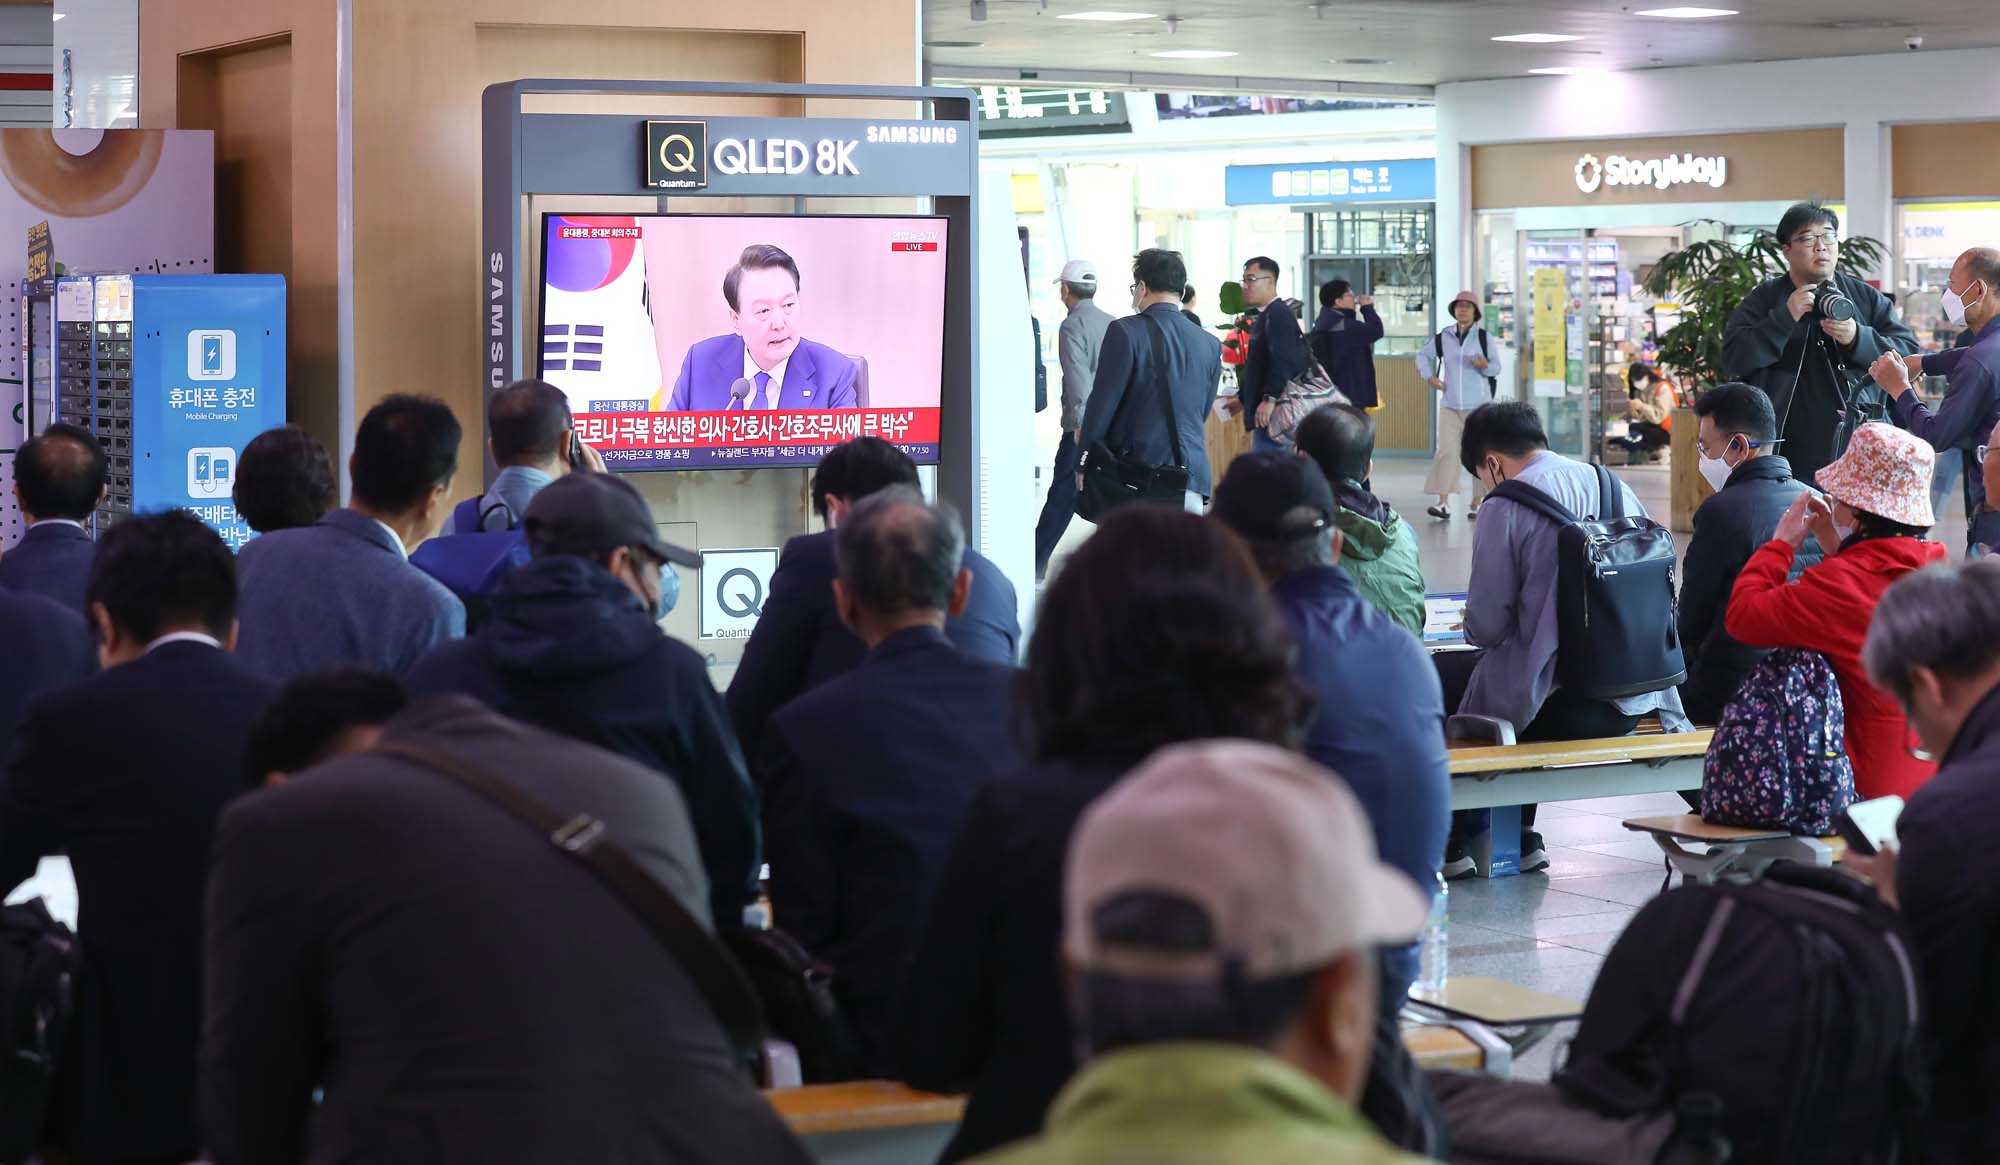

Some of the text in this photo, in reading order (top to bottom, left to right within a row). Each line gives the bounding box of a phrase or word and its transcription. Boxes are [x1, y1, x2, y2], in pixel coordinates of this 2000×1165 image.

[866, 126, 957, 143] SAMSUNG
[659, 133, 697, 173] Q
[713, 138, 860, 175] QLED 8K
[1604, 153, 1726, 189] StoryWay
[659, 179, 696, 188] Quantum
[906, 243, 923, 251] LIVE
[490, 252, 504, 389] SAMSU
[168, 387, 256, 409] 휴대폰 충전
[593, 400, 645, 412] 용산 대통령실
[185, 412, 238, 422] Mobile Charging
[620, 417, 650, 445] 극복
[653, 416, 697, 444] 헌신한
[864, 413, 879, 437] 큰
[655, 449, 672, 461] 명품
[673, 449, 690, 460] 쇼핑
[717, 448, 750, 459] 뉴질랜드
[752, 447, 775, 457] 부자들
[797, 446, 806, 456] 더
[808, 446, 824, 456] 내게
[717, 567, 763, 618] Q
[716, 628, 752, 638] Quantu
